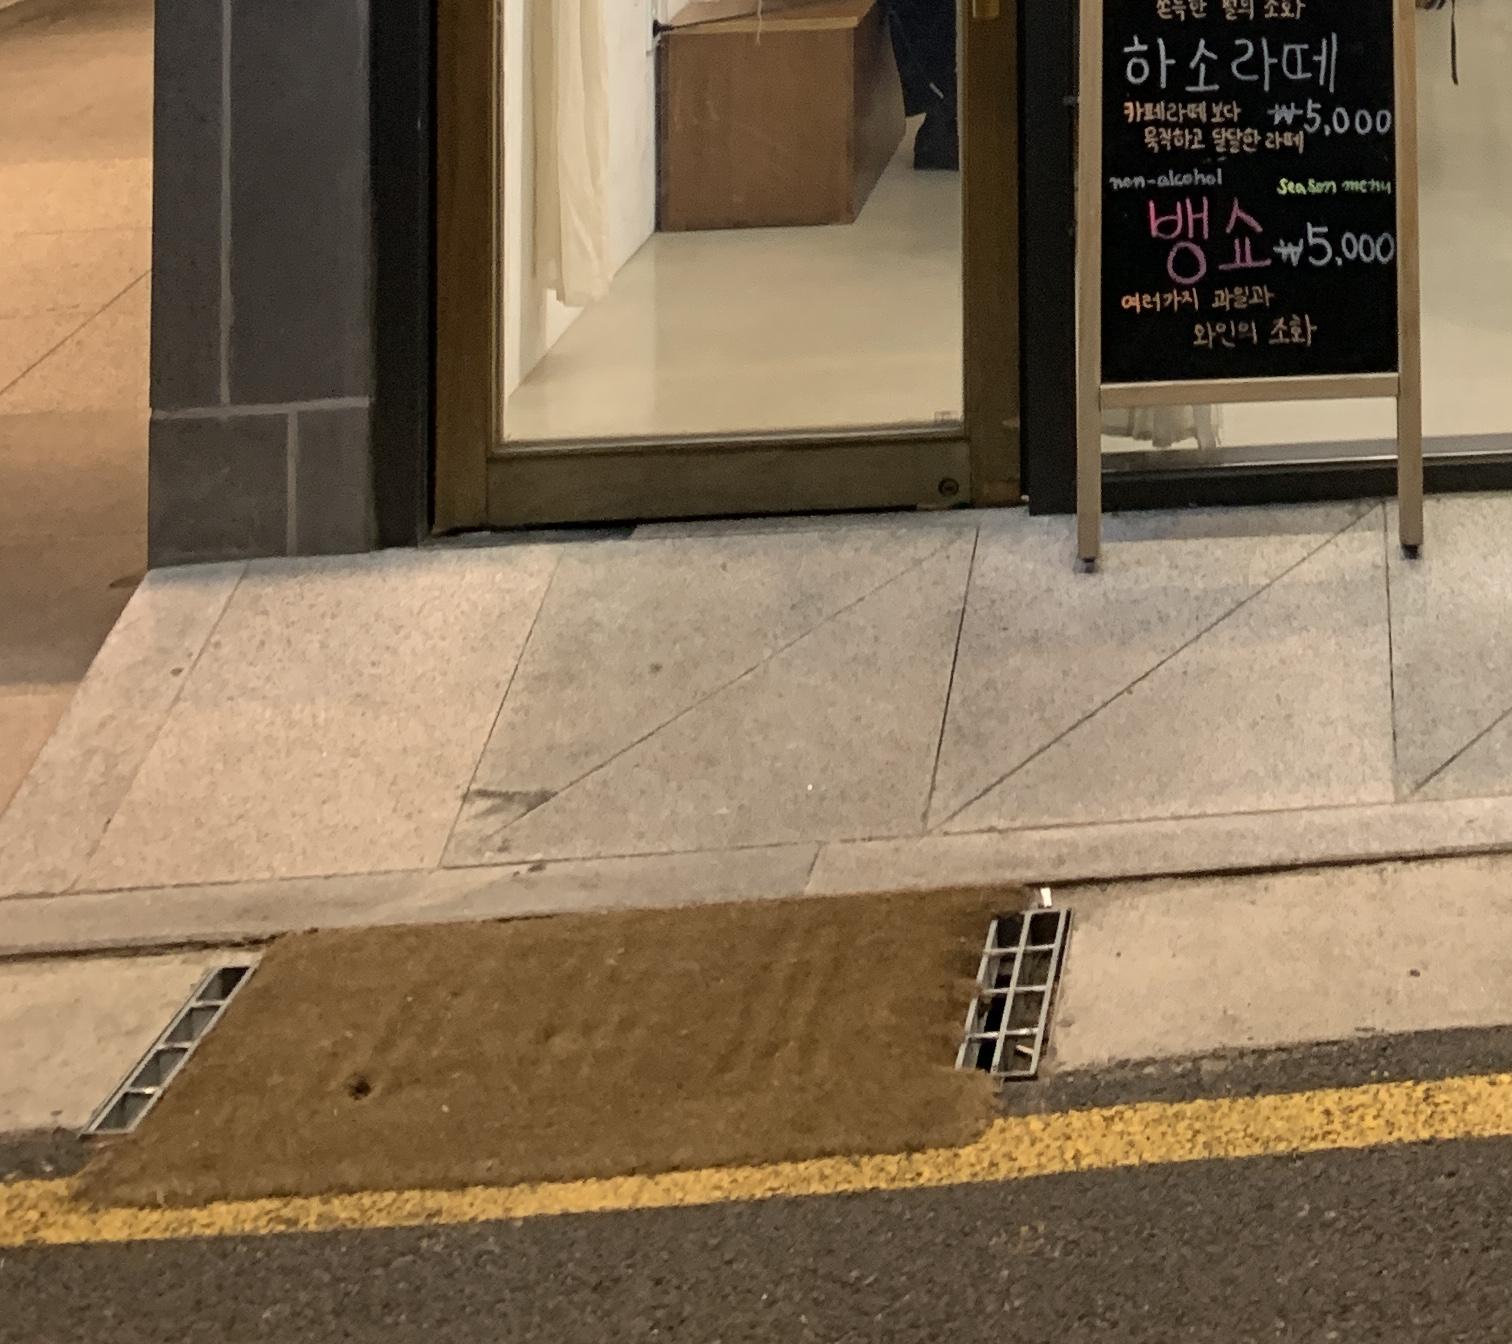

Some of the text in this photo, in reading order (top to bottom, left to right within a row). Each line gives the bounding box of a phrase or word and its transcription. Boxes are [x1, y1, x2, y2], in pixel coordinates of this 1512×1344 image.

[1211, 127, 1262, 154] 달달한
[1264, 130, 1305, 154] 라떼
[1109, 168, 1223, 190] non-alcohol
[1121, 284, 1275, 314] 여러가지 과일과
[1193, 314, 1318, 349] 와인의 조화
